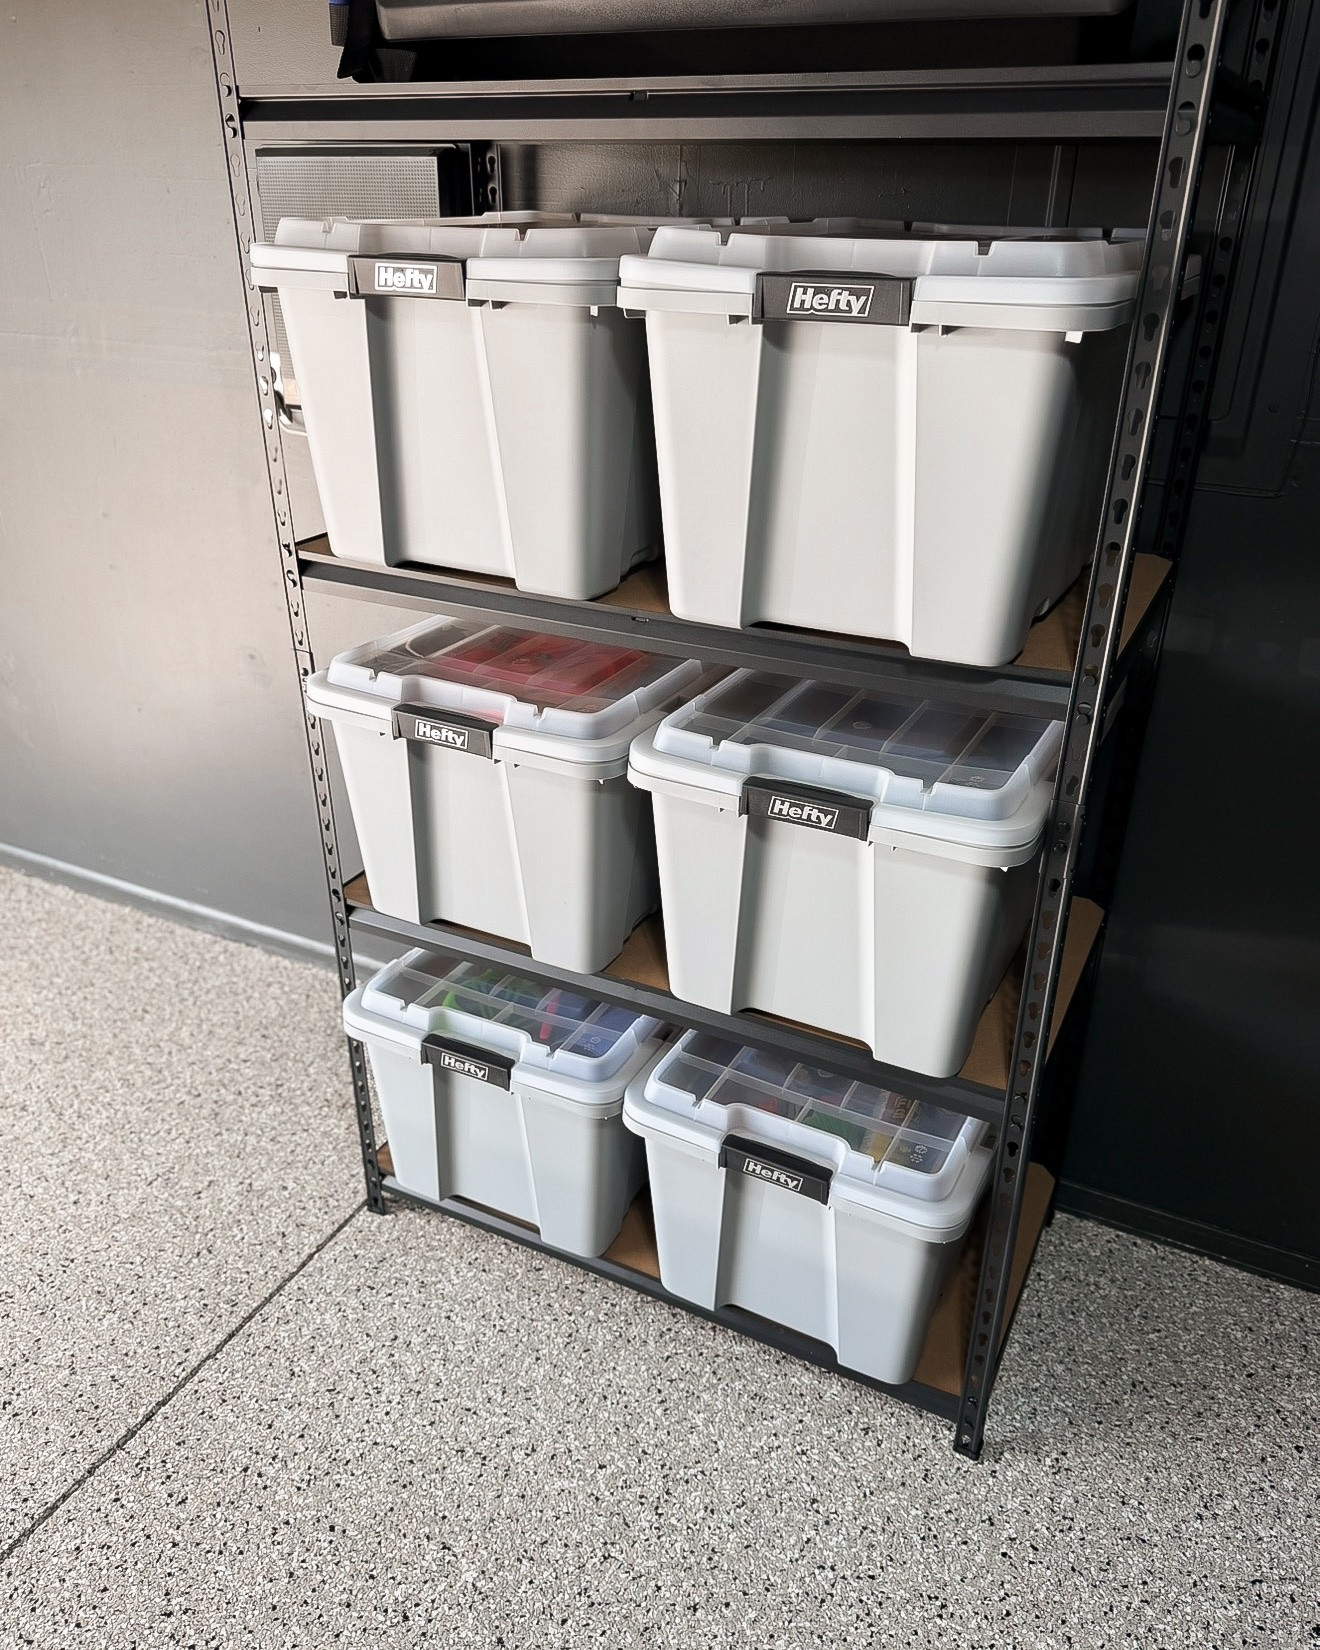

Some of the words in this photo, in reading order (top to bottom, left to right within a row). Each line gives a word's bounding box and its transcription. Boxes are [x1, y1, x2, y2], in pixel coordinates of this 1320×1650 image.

[379, 267, 433, 291] Hefty
[793, 287, 868, 315] Hefty
[418, 722, 465, 747] Hefty
[773, 800, 833, 827] Hefty
[444, 1055, 486, 1078] Hefty
[748, 1162, 799, 1188] Hefty
